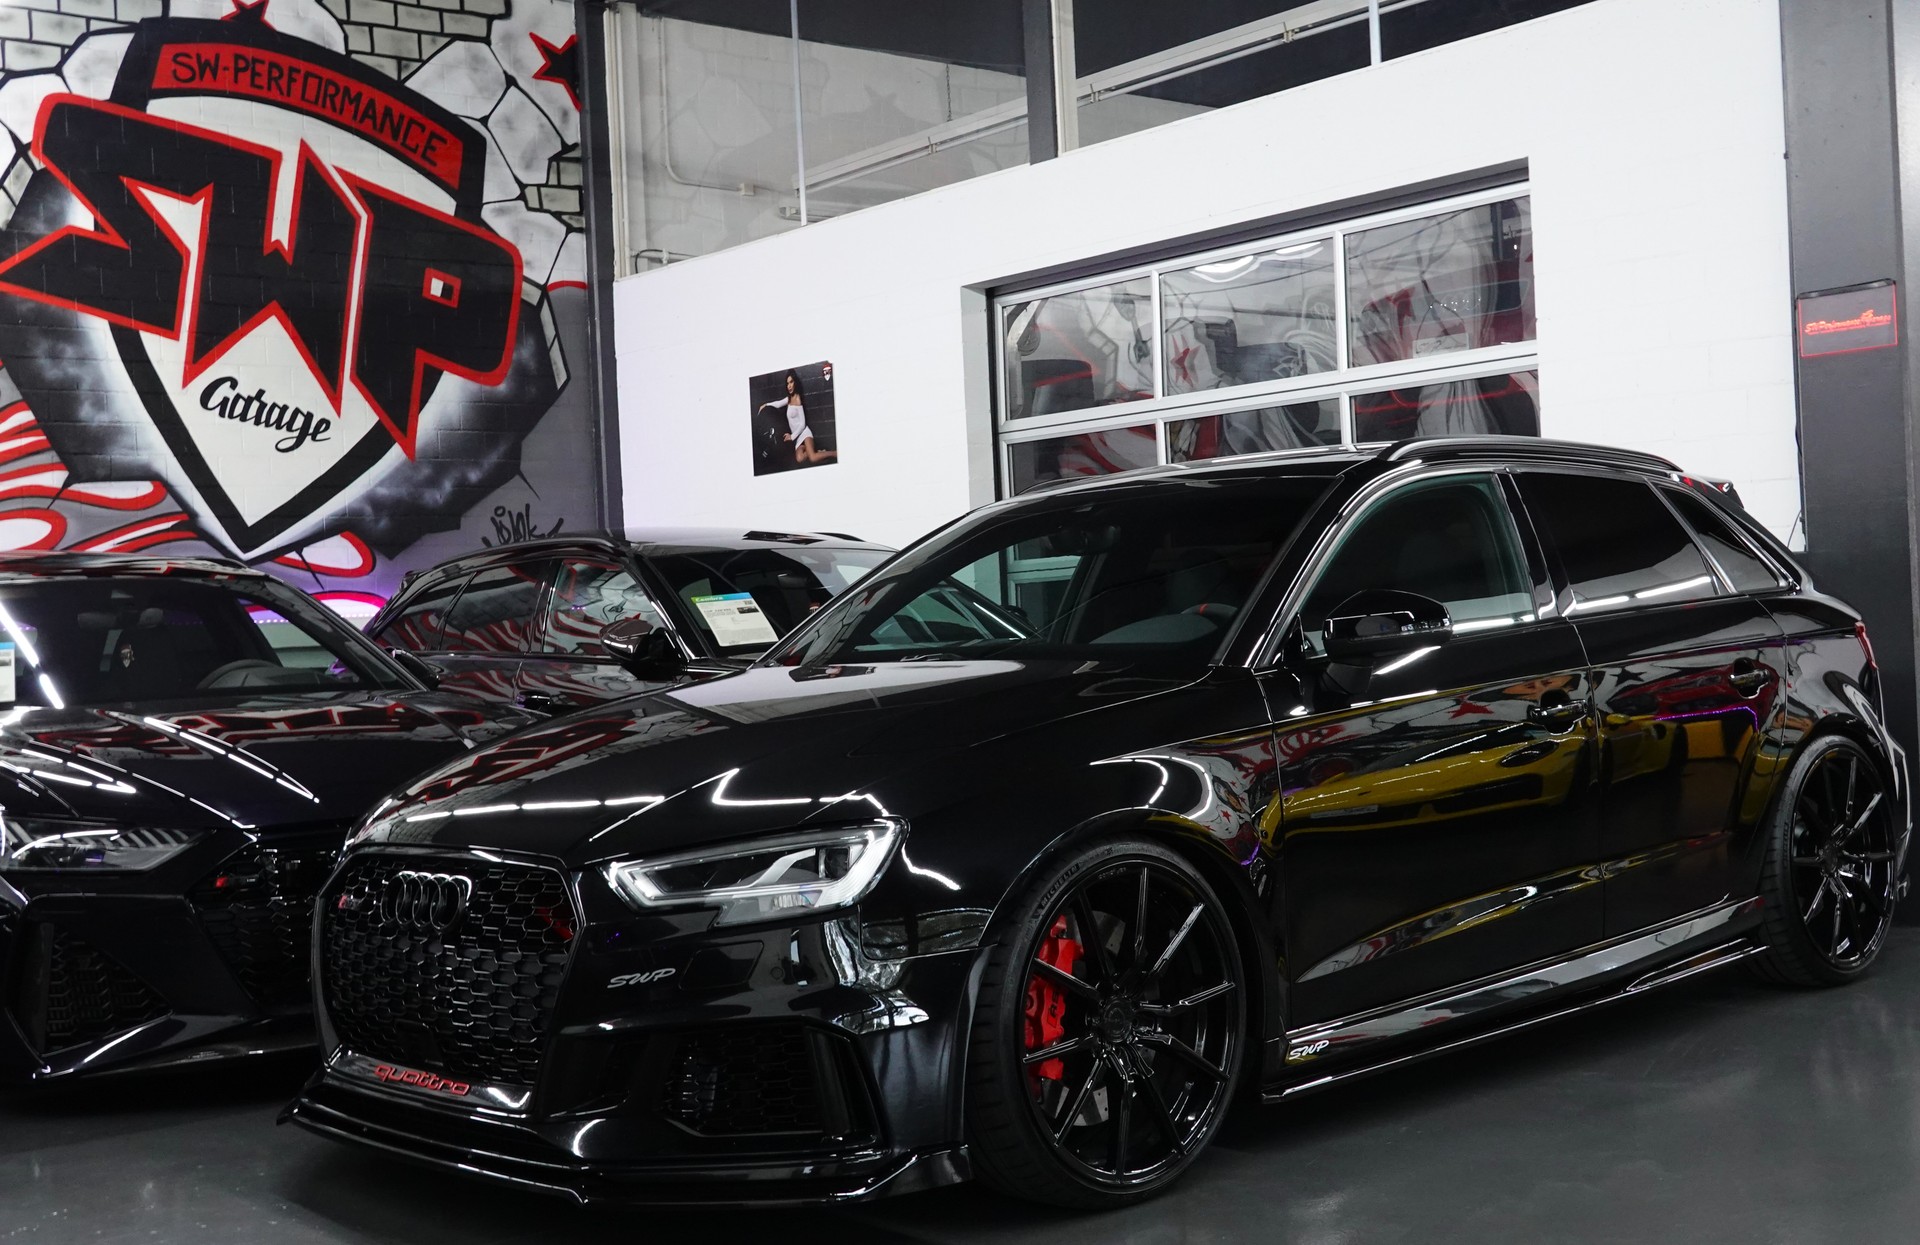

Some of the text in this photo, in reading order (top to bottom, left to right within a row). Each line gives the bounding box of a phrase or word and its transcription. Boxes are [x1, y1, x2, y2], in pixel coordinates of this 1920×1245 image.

[172, 52, 447, 167] SW-PERFORMANCE
[0, 92, 523, 462] SWP
[199, 376, 331, 453] Garage
[607, 967, 676, 988] SWP
[1288, 1039, 1330, 1060] SWP
[374, 1064, 470, 1096] quattro
